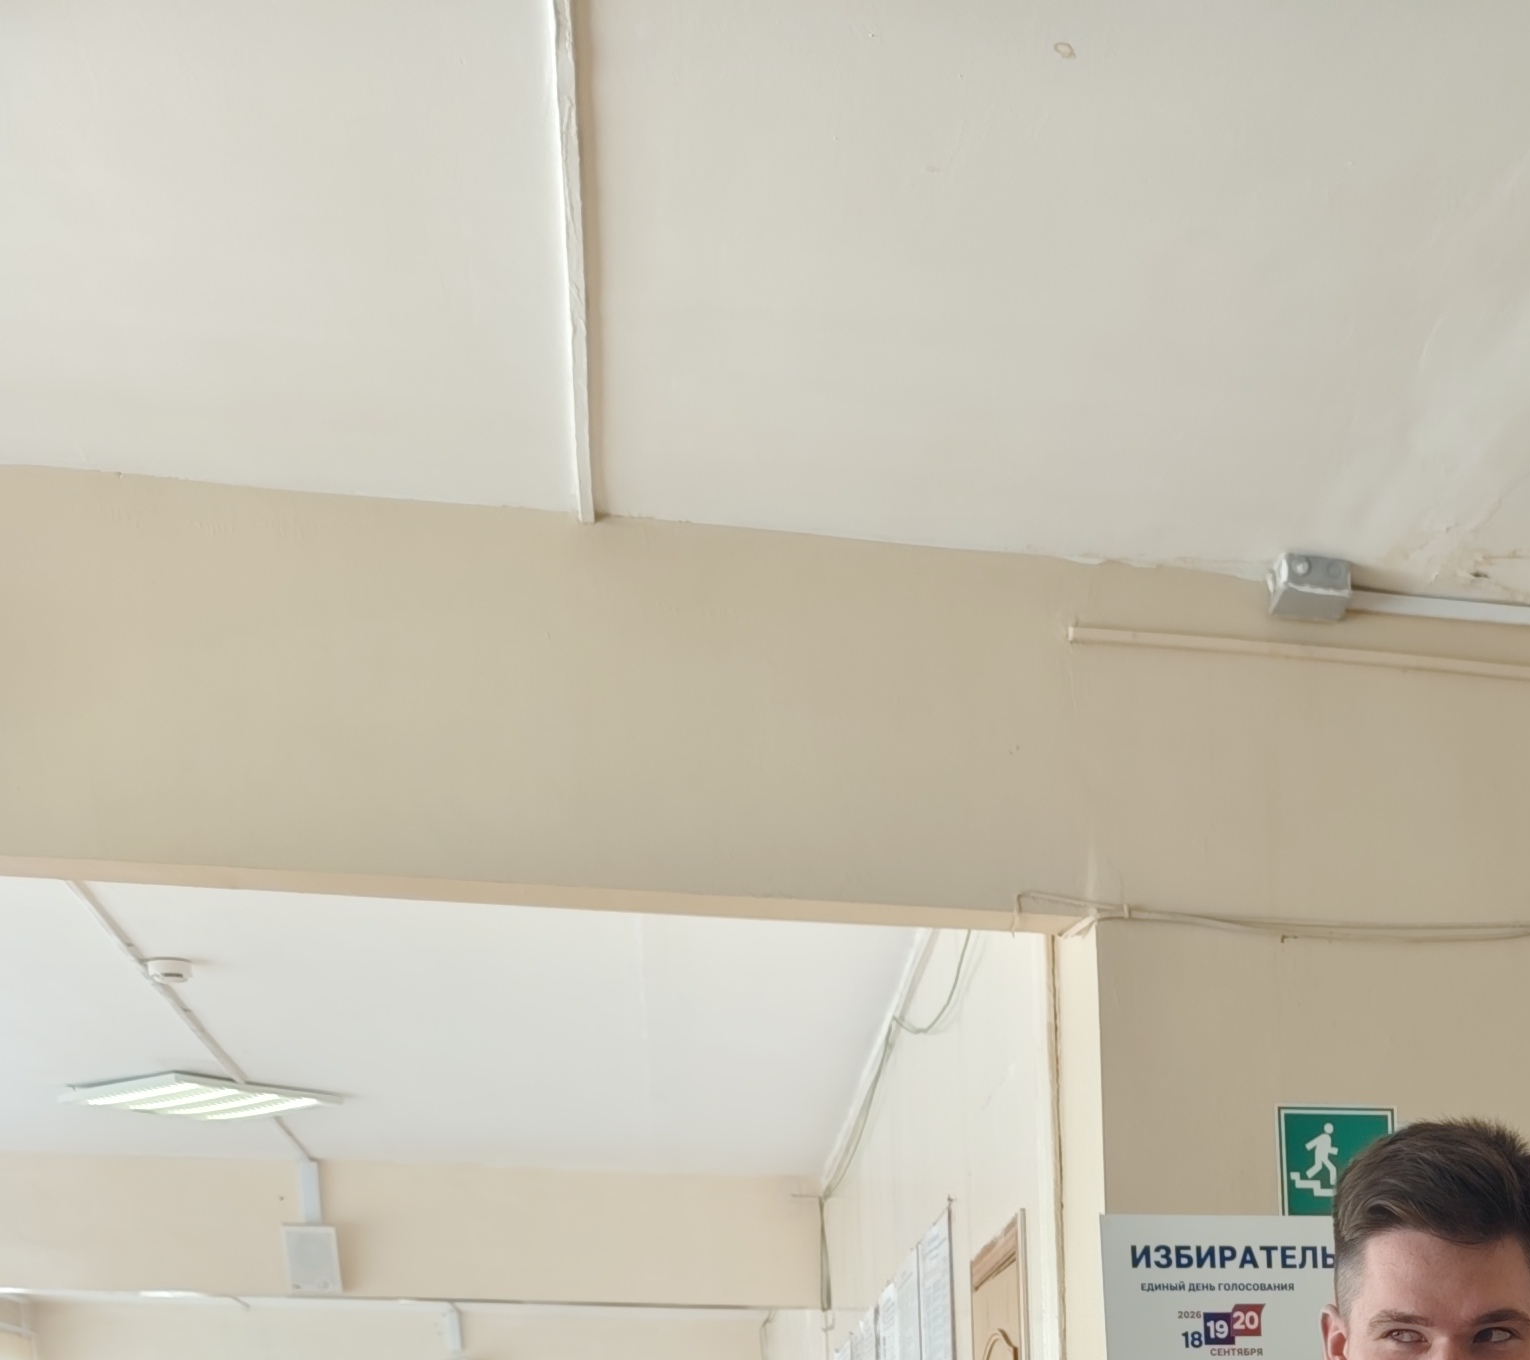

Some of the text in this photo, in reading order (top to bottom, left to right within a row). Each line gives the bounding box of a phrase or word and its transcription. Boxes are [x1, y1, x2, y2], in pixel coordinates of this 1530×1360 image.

[1131, 1245, 1336, 1269] ИЗБИРАТЕЛЬ
[1141, 1281, 1295, 1292] ЕДИНЫЙ ДЕНЬ ГОЛОСОВАНИЯ
[1178, 1311, 1202, 1319] 2026
[1182, 1311, 1259, 1349] 18 19 20
[1210, 1348, 1264, 1357] СЕНТЯБРЯ
